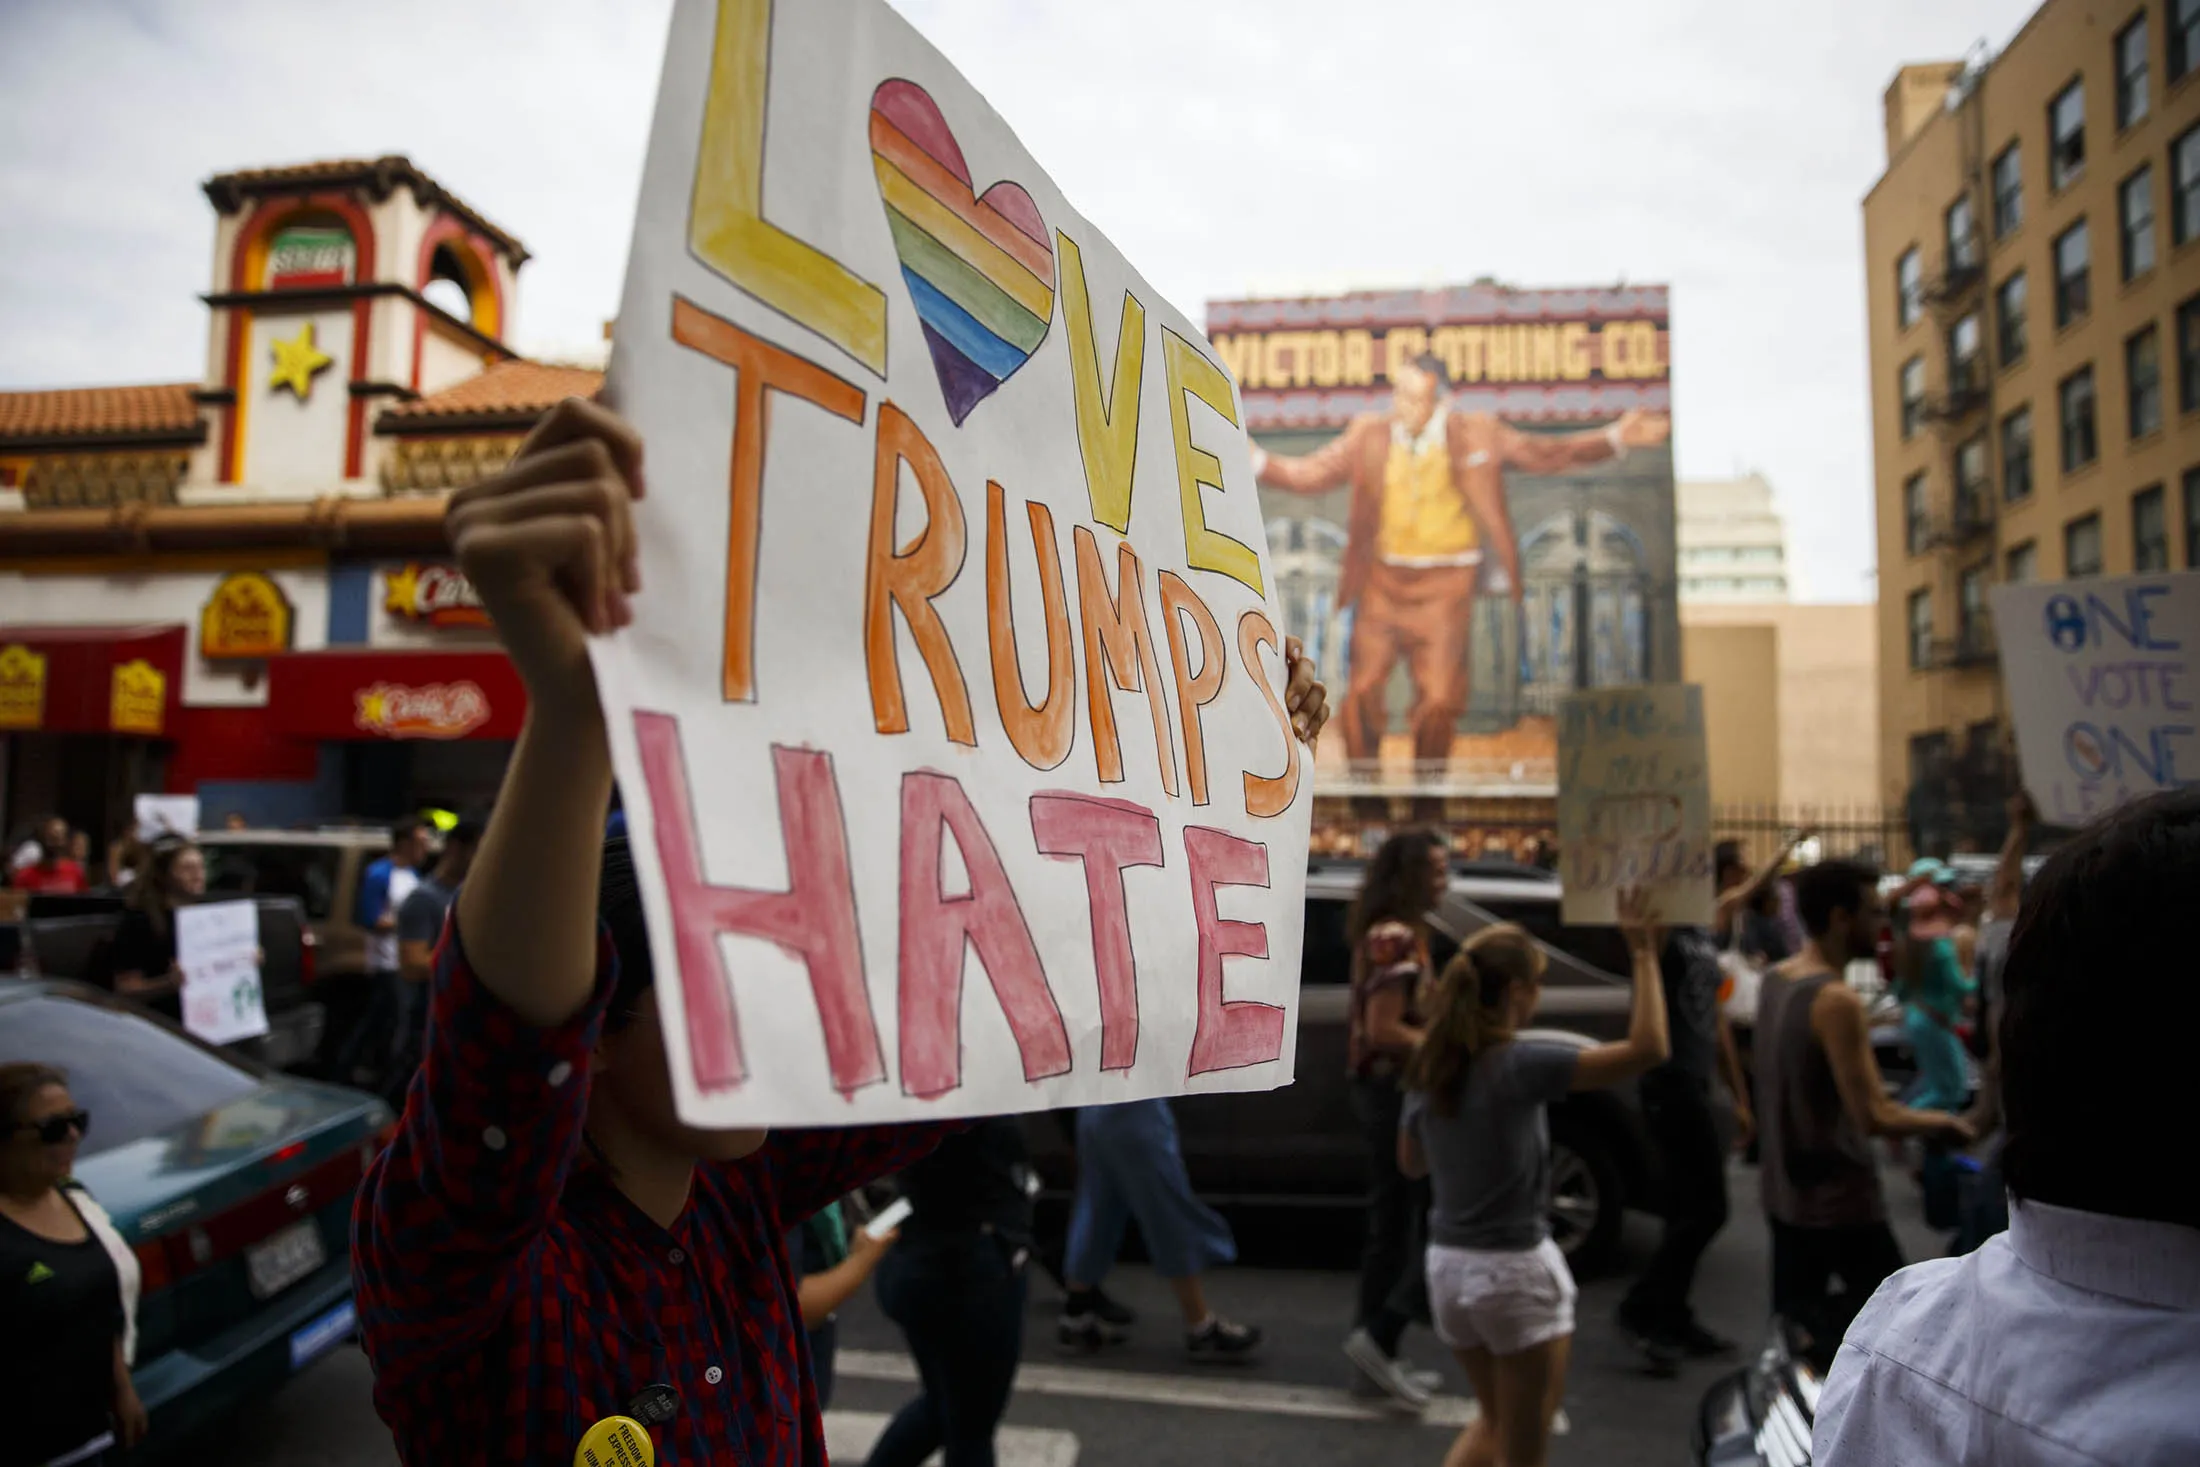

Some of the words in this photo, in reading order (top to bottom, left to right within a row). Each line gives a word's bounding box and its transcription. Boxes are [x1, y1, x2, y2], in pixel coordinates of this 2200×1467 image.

[1213, 329, 1375, 388] VICTOR
[671, 291, 1301, 818] TRUMPS
[2043, 585, 2181, 653] ONE
[2065, 660, 2193, 710] VOTE
[2063, 721, 2200, 787] ONE
[631, 709, 1286, 1101] HATE
[584, 1448, 601, 1467] HUM
[608, 1433, 633, 1467] EXPRESS
[619, 1424, 643, 1462] FREEDOM
